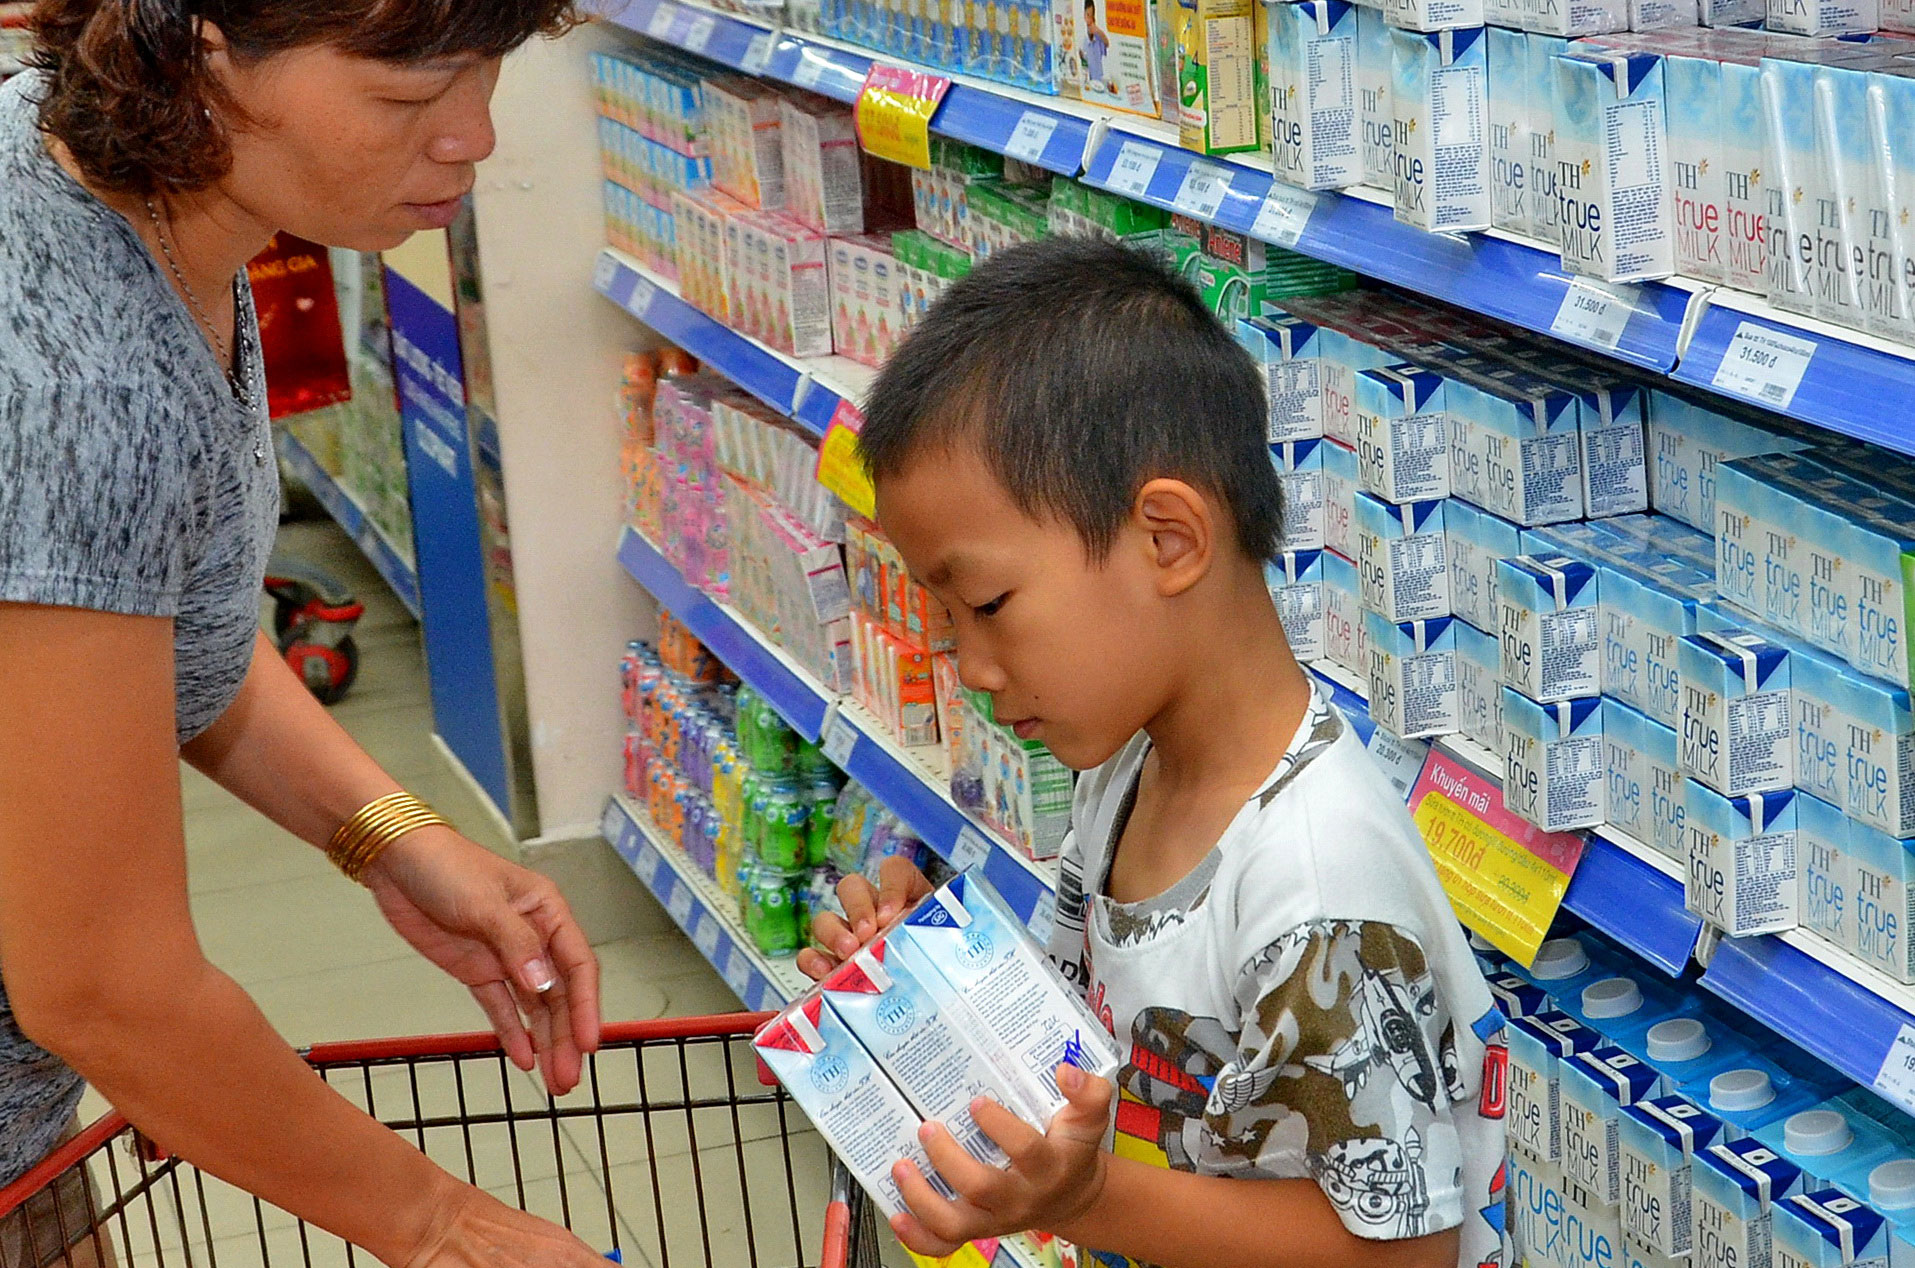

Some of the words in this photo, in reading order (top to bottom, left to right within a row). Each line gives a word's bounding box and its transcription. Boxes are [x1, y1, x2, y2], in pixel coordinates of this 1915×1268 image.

[1271, 87, 1288, 110] TH
[1361, 88, 1376, 112] TH
[1272, 115, 1301, 146] true
[1361, 118, 1392, 149] true
[1394, 120, 1409, 145] TH
[1492, 123, 1508, 149] TH
[1531, 133, 1547, 159] TH
[1274, 146, 1304, 173] MILK
[1393, 151, 1424, 184] true
[1492, 156, 1524, 189] true
[1558, 161, 1580, 190] TH
[1675, 162, 1697, 190] TH
[1394, 182, 1425, 213] MILK
[1726, 171, 1749, 200] TH
[1560, 197, 1600, 232] true
[1675, 190, 1719, 234] true
[1727, 201, 1764, 244] true
[1562, 230, 1603, 264] MILK
[1677, 231, 1720, 264] MILK
[1767, 220, 1813, 260] true
[1817, 229, 1864, 276] true
[1574, 295, 1600, 313] 31.500
[1739, 346, 1770, 366] 31.500
[1325, 385, 1349, 416] true
[1357, 414, 1372, 437] TH
[1451, 420, 1468, 444] TH
[1357, 433, 1384, 468] true
[1451, 441, 1479, 475] true
[1485, 434, 1503, 459] TH
[1658, 432, 1676, 456] TH
[1360, 459, 1386, 491] MILK
[1485, 454, 1515, 491] true
[1658, 452, 1688, 490] true
[1722, 511, 1742, 539] TH
[1359, 533, 1373, 557] TH
[1722, 531, 1755, 577] true
[1766, 531, 1787, 560] TH
[1359, 554, 1384, 588] true
[1453, 560, 1478, 595] true
[1722, 563, 1755, 605] MILK
[1765, 552, 1799, 598] true
[1811, 552, 1832, 582] TH
[1362, 580, 1387, 613] MILK
[1766, 586, 1799, 627] MILK
[1810, 575, 1847, 621] true
[1860, 575, 1882, 605] TH
[1503, 605, 1520, 632] TH
[1608, 612, 1625, 639] TH
[1812, 607, 1848, 649] MILK
[1858, 598, 1897, 645] true
[1370, 650, 1384, 674] TH
[1502, 625, 1531, 666] true
[1606, 634, 1637, 673] true
[1647, 633, 1665, 659] TH
[1859, 630, 1899, 673] MILK
[1371, 667, 1395, 705] true
[1504, 656, 1532, 691] MILK
[1646, 654, 1679, 694] true
[1372, 696, 1396, 728] MILK
[1462, 679, 1486, 718] true
[1685, 686, 1706, 716] TH
[1799, 700, 1821, 728] TH
[1509, 732, 1526, 759] TH
[1683, 707, 1719, 755] true
[1798, 722, 1837, 767] true
[1847, 724, 1870, 754] TH
[1508, 752, 1537, 794] true
[1609, 743, 1627, 771] TH
[1683, 738, 1719, 787] MILK
[1847, 747, 1887, 794] true
[1430, 763, 1469, 801] Khuyến
[1469, 790, 1491, 815] mãi
[1608, 765, 1640, 806] true
[1652, 766, 1671, 793] TH
[1800, 754, 1838, 795] MILK
[1508, 783, 1538, 818] MILK
[1609, 793, 1641, 830] MILK
[1652, 786, 1685, 829] true
[1849, 781, 1888, 822] MILK
[1424, 815, 1488, 871] 19.700đ
[1653, 818, 1685, 851] MILK
[1690, 827, 1710, 857] TH
[1689, 850, 1724, 896] true
[1808, 841, 1830, 872] TH
[1807, 864, 1843, 911] true
[1858, 869, 1881, 899] TH
[1691, 881, 1725, 922] MILK
[1808, 896, 1844, 938] MILK
[1857, 890, 1897, 939] true
[885, 1005, 907, 1024] TH
[822, 1064, 841, 1083] TH
[1510, 1063, 1529, 1091] TH
[1509, 1084, 1540, 1127] true
[1565, 1102, 1586, 1131] TH
[1509, 1112, 1541, 1150] MILK
[1564, 1122, 1598, 1167] true
[1567, 1152, 1600, 1192] MILK
[1626, 1153, 1647, 1183] TH
[1510, 1155, 1559, 1225] true
[1625, 1177, 1660, 1221] true
[1559, 1196, 1612, 1263] true
[1626, 1205, 1662, 1246] MILK
[1700, 1199, 1722, 1231] TH
[1699, 1221, 1737, 1267] true
